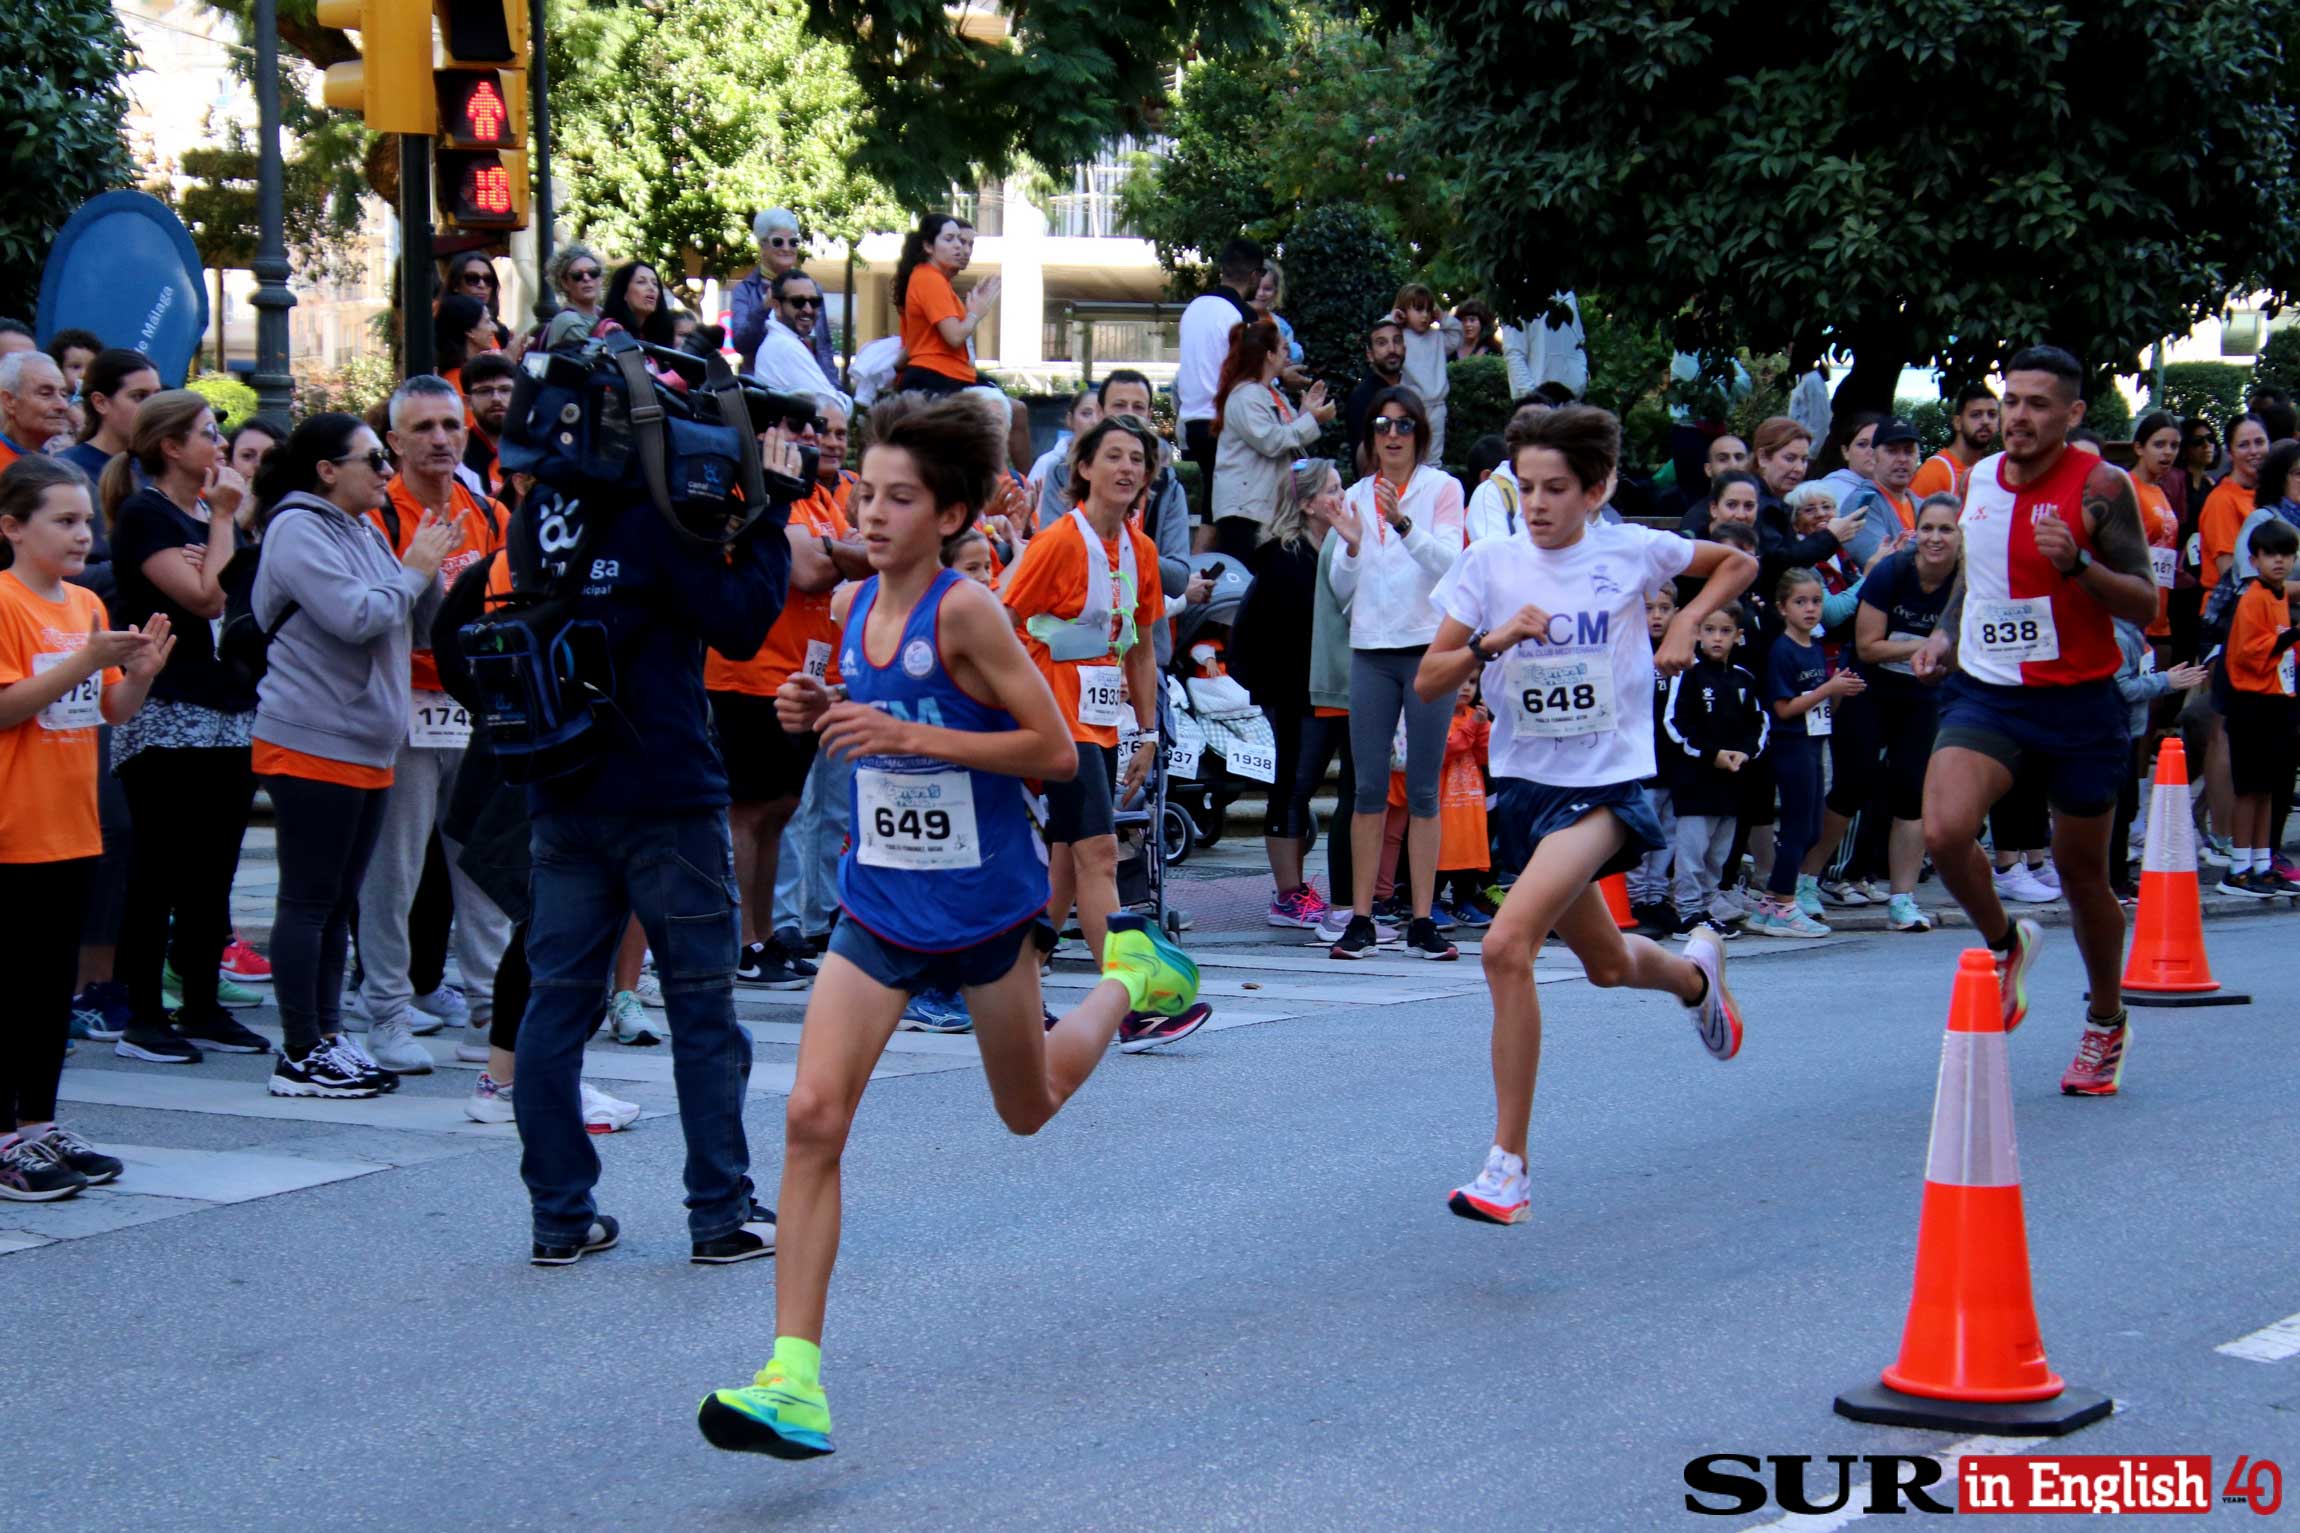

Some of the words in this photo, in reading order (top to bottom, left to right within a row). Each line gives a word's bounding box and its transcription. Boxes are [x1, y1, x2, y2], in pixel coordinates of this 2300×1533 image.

[1983, 621, 2038, 644] 838
[57, 678, 98, 703] 724
[1522, 683, 1595, 714] 648
[1232, 752, 1272, 770] 1938
[875, 806, 951, 841] 649
